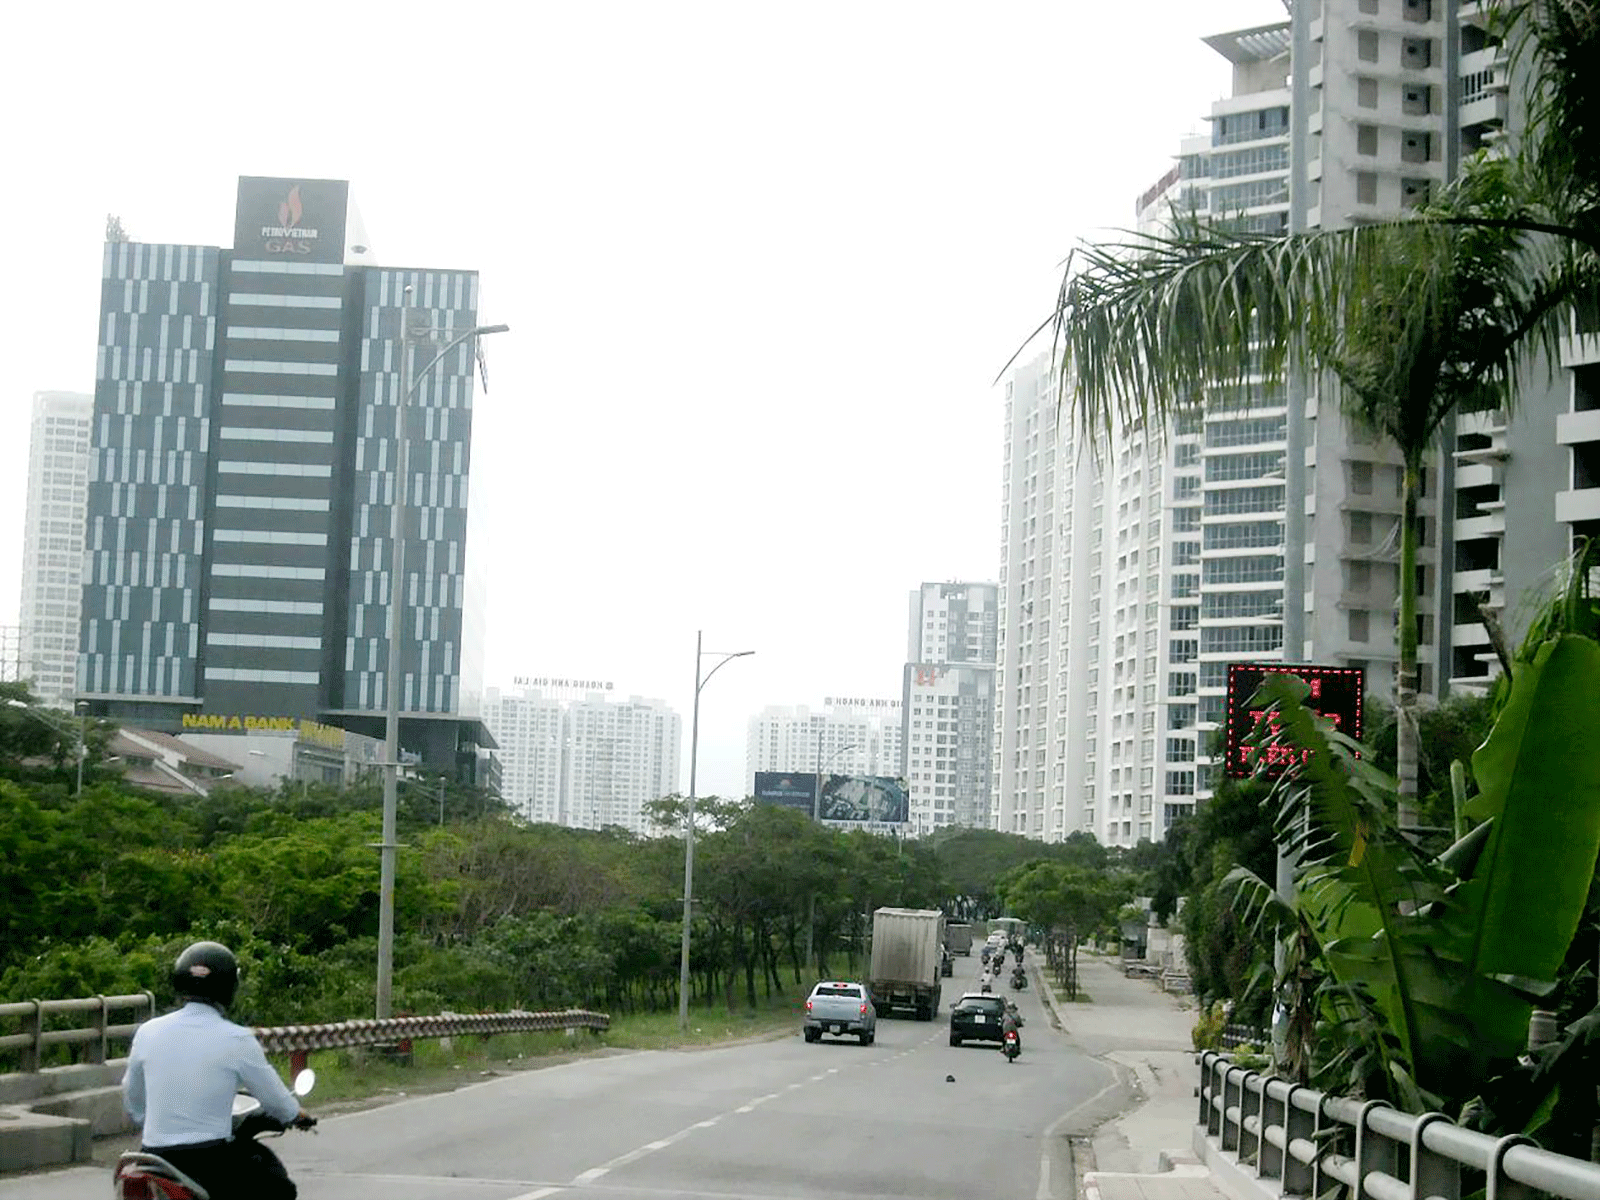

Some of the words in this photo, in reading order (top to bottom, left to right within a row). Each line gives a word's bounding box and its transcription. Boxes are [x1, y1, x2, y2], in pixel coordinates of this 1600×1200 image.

[265, 240, 311, 254] GAS
[836, 698, 866, 707] HOANG
[869, 699, 887, 708] ANH
[182, 713, 226, 728] NAM
[244, 715, 294, 731] BANK
